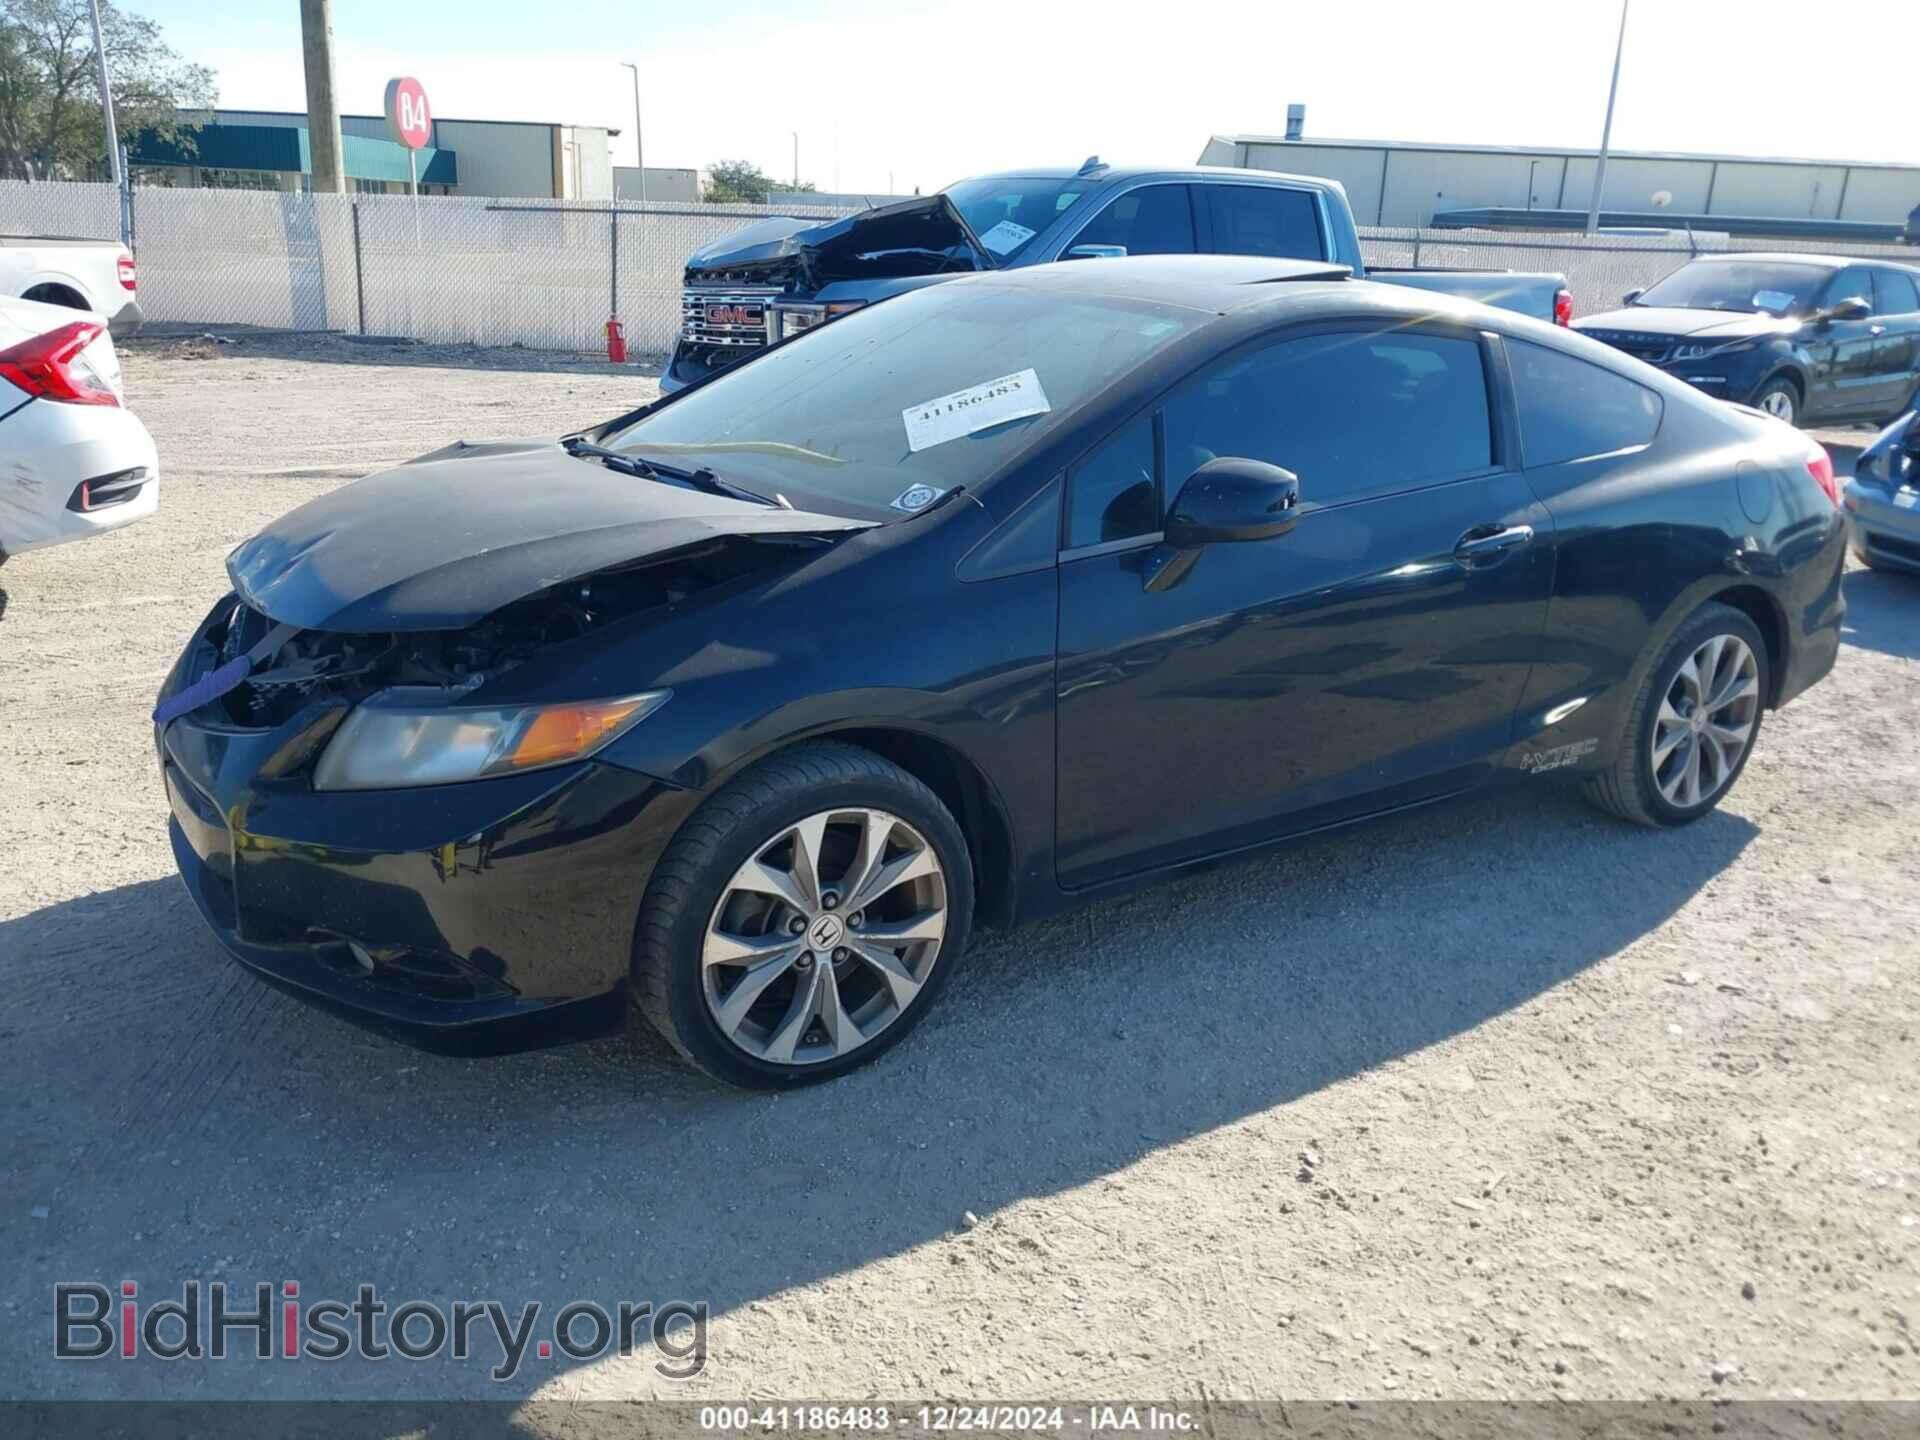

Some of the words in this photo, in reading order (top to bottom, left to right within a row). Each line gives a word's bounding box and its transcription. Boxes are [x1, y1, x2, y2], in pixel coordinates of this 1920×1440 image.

[400, 91, 427, 133] 84
[706, 304, 763, 324] GMC
[918, 381, 1021, 422] 41186483
